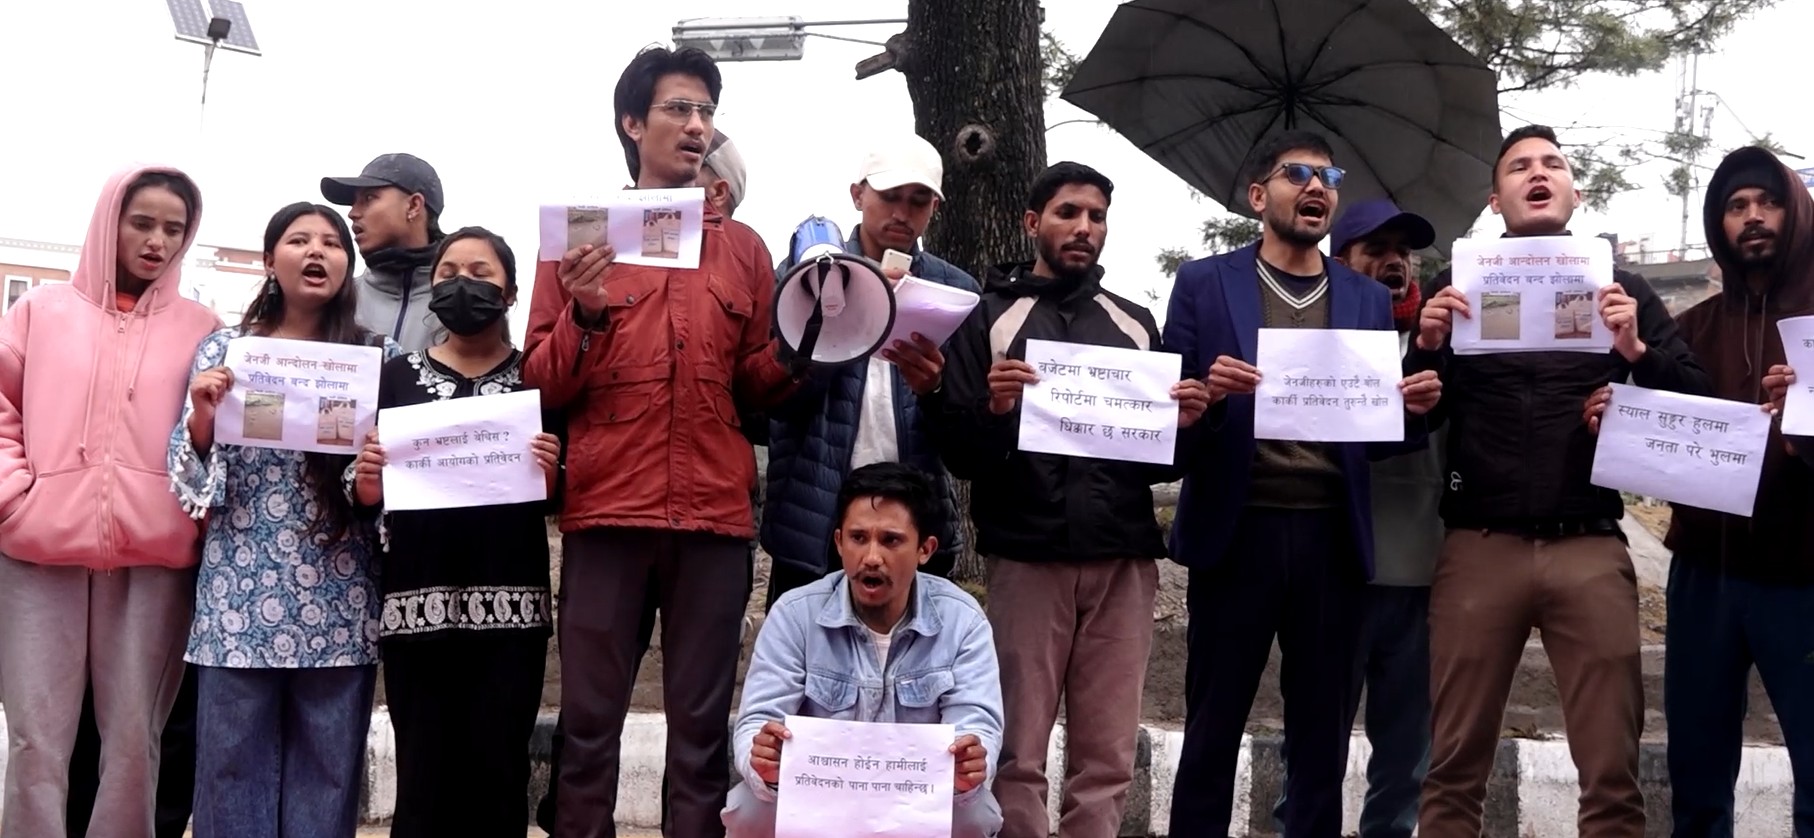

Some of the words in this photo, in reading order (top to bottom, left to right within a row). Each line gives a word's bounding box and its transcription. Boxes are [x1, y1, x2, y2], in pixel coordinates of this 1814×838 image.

[1477, 254, 1503, 267] जेनजी
[1508, 253, 1551, 266] आन्दोलन
[1554, 252, 1590, 266] खोलामा
[1481, 272, 1520, 285] प्रतिवेदन
[1549, 271, 1585, 285] झोलामा
[244, 352, 271, 364] जेनजी
[276, 355, 317, 370] आन्दोलन
[322, 358, 358, 373] खोलामा
[248, 371, 285, 386] प्रतिवेदन
[315, 376, 349, 391] झोलामा
[1087, 366, 1132, 382] भ्रष्टाचार
[1050, 388, 1096, 406] रिपोर्टमा
[1103, 396, 1153, 413] चमत्कार
[1272, 393, 1298, 406] कार्की
[1302, 394, 1339, 407] प्रतिवेदन
[1371, 394, 1388, 407] खोल
[1618, 404, 1651, 420] स्याल
[1692, 416, 1729, 434] हुलमा
[1060, 417, 1096, 436] धिक्कार
[1102, 424, 1115, 440] छ
[1121, 427, 1162, 442] सरकार
[412, 438, 430, 451] कुन
[1645, 437, 1679, 453] जनता
[1686, 441, 1703, 459] परे
[1710, 449, 1747, 467] भुलमा
[405, 456, 431, 469] कार्की
[437, 454, 478, 467] आयोगको
[484, 451, 520, 464] प्रतिवेदन
[885, 757, 928, 772] हामीलाई
[795, 773, 844, 790] प्रतिवेदनको
[849, 781, 868, 791] पाना
[872, 782, 891, 792] पाना
